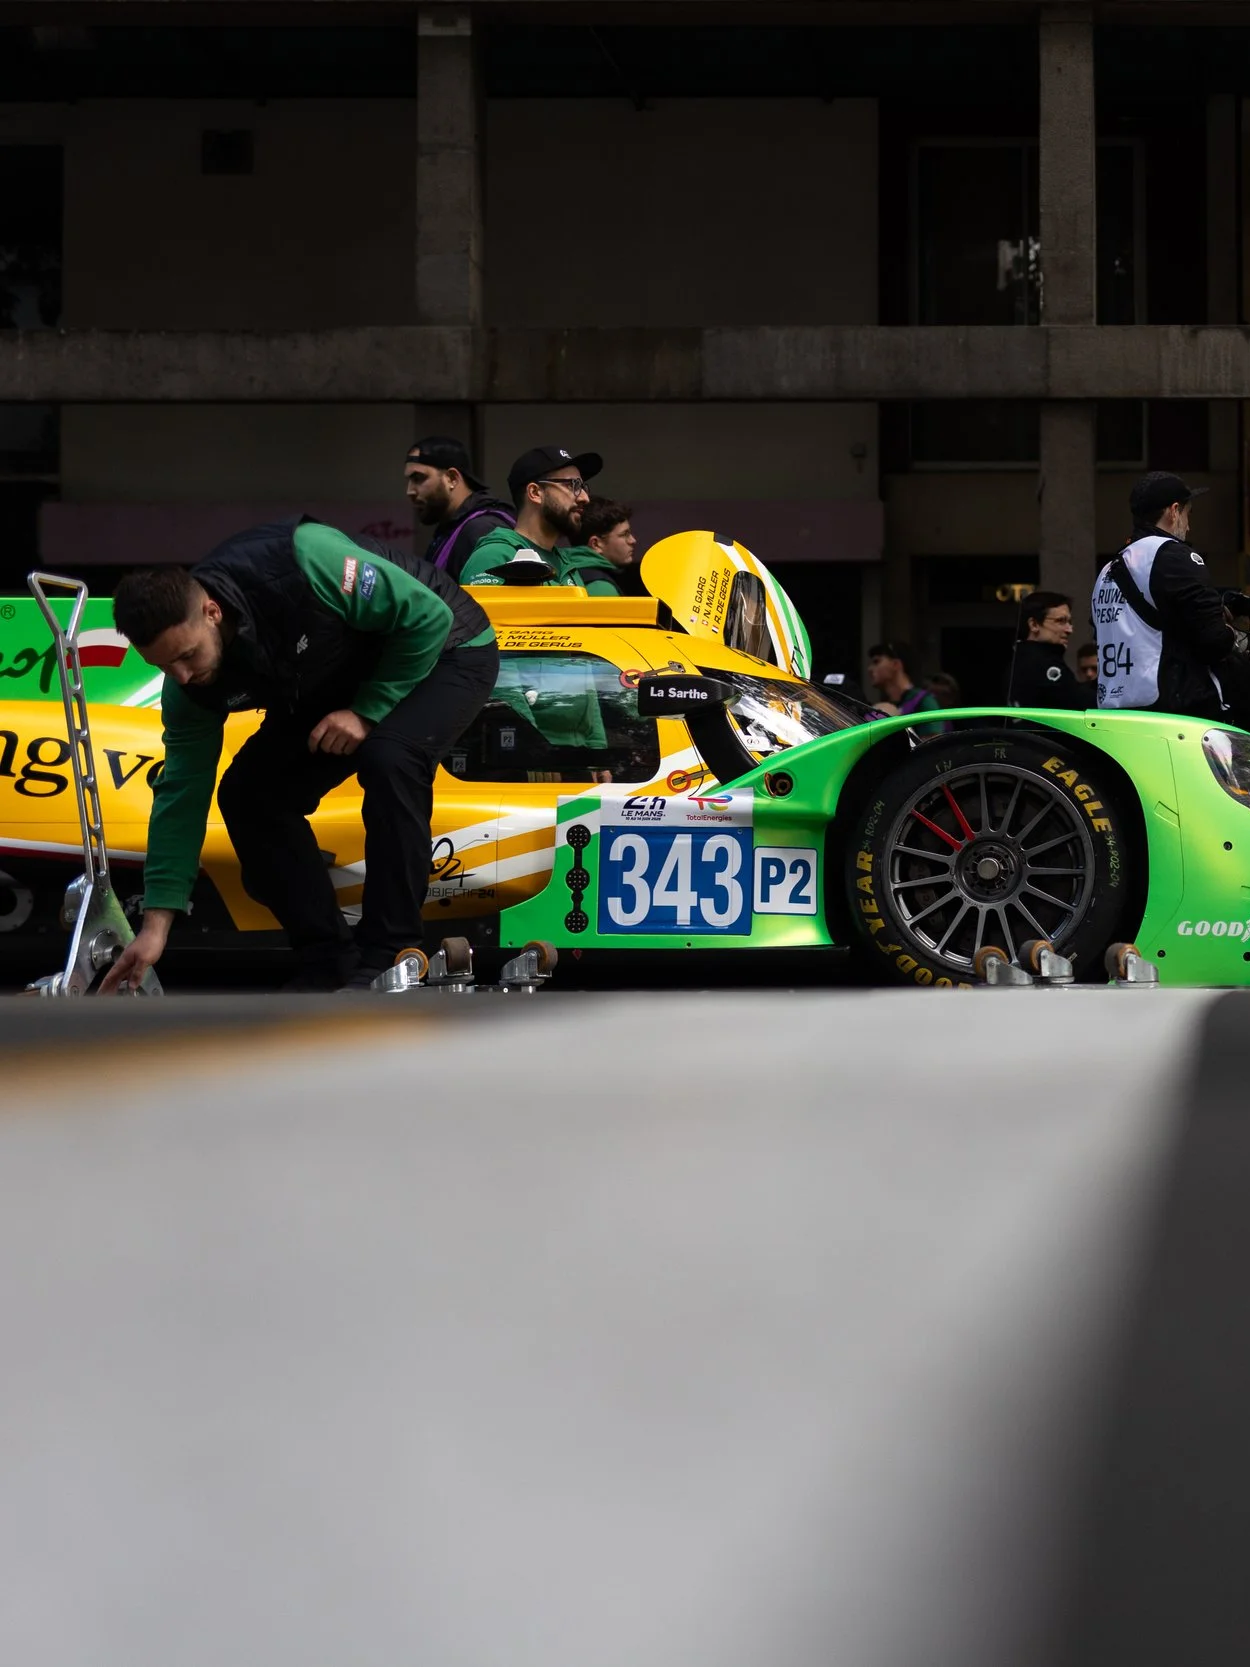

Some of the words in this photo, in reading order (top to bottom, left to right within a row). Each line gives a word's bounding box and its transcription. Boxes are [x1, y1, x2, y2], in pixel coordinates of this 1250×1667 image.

[362, 579, 371, 594] AVL
[694, 576, 707, 603] GARG
[719, 568, 731, 600] GERUS
[716, 600, 725, 614] DE
[1097, 642, 1134, 678] 84
[650, 686, 664, 698] La
[668, 687, 708, 700] Sarthe
[1041, 755, 1113, 833] EAGLE
[686, 814, 733, 822] TotalEnergies
[607, 833, 744, 927] 343
[760, 857, 812, 905] P2
